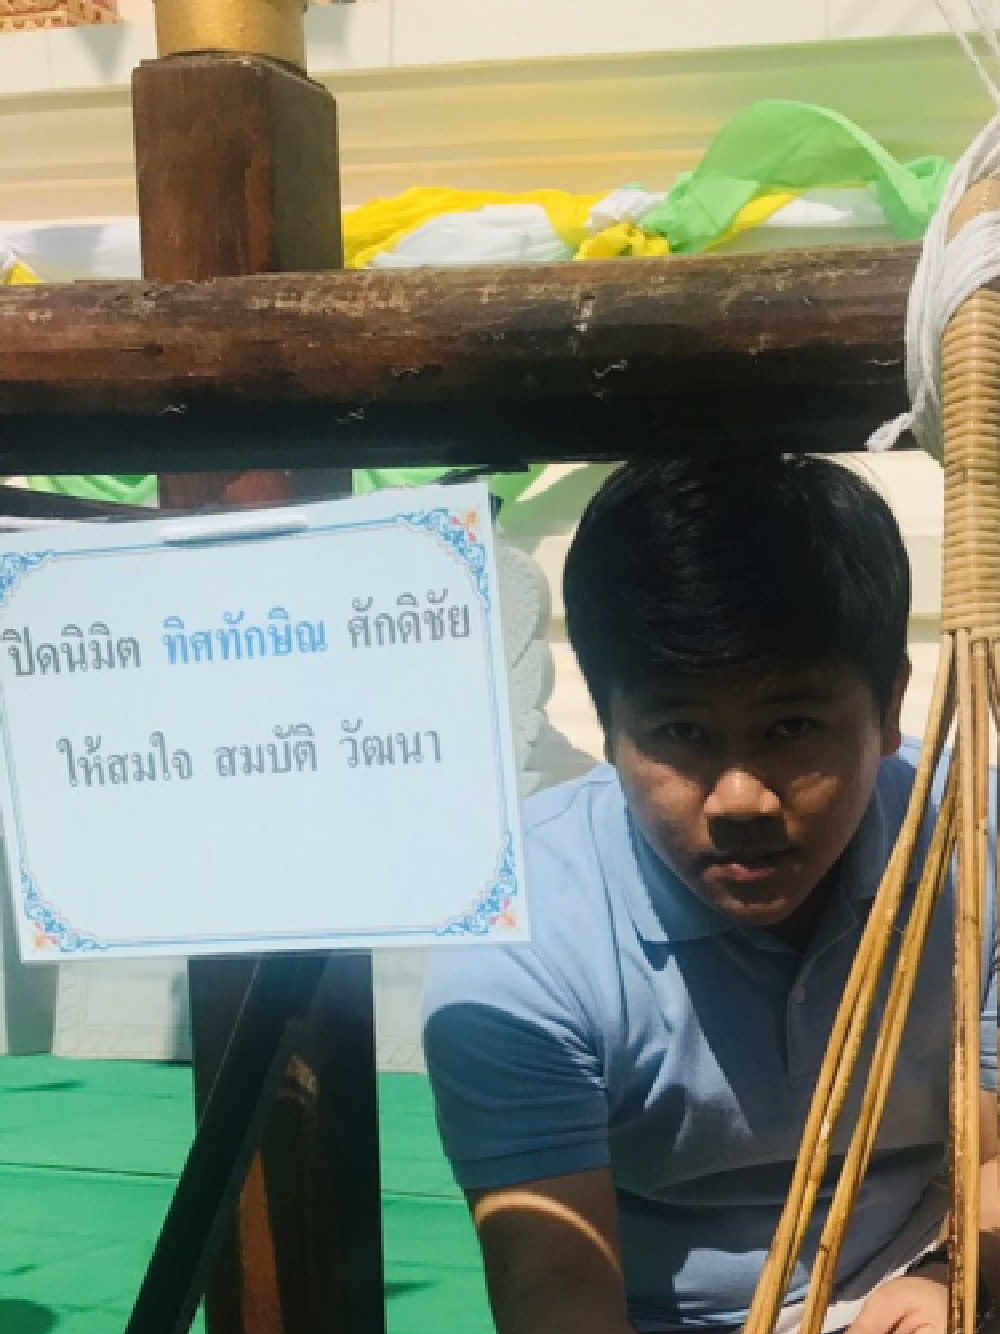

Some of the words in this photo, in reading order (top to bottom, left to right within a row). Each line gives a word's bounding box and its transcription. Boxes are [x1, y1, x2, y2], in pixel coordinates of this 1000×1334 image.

[2, 620, 142, 677] ปิดนิมิต
[163, 606, 328, 665] ทิศทักษิณ
[347, 588, 470, 649] ศักดิชัย
[56, 730, 194, 788] ให้สมใจ
[214, 722, 318, 777] สมบัติ
[339, 717, 443, 769] วัฒนา
